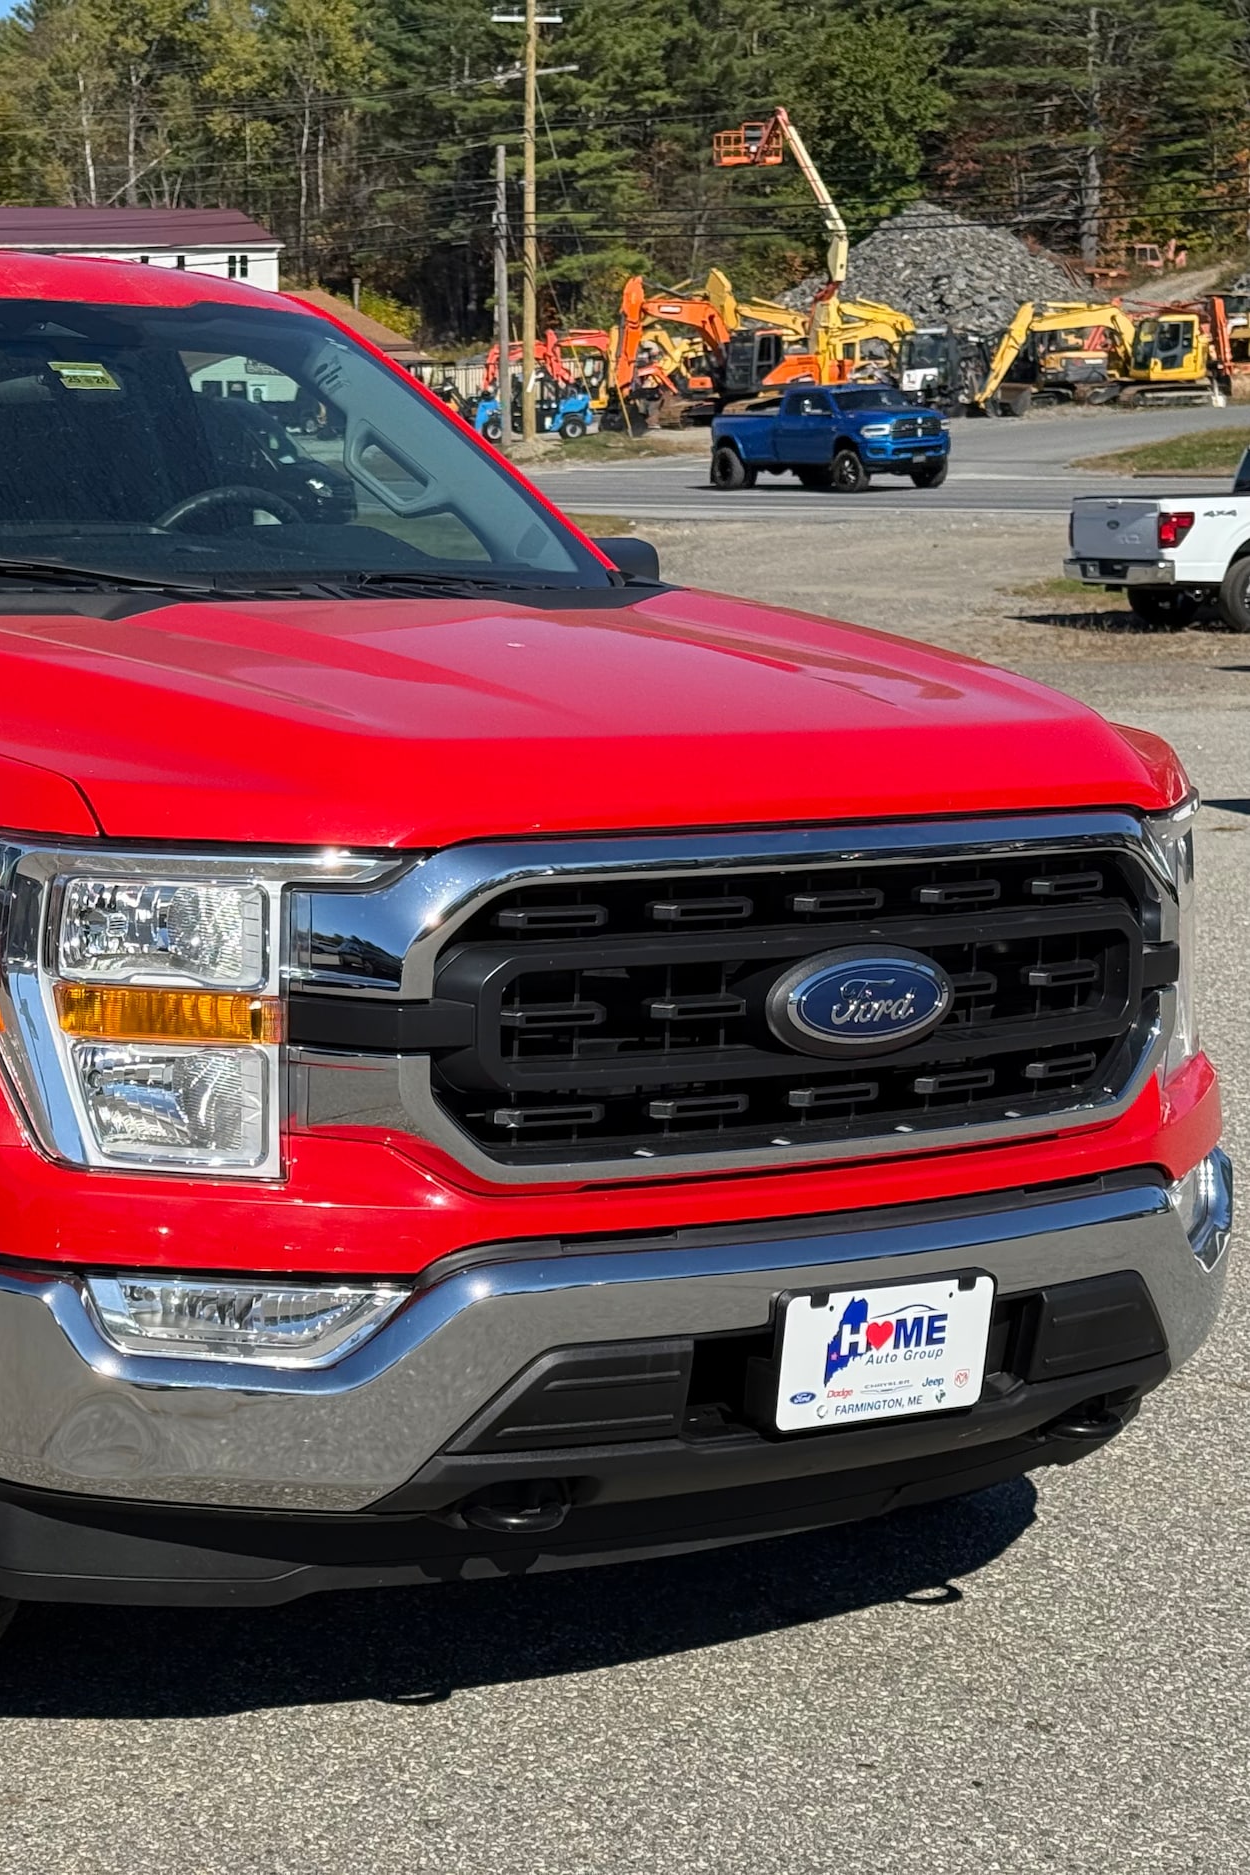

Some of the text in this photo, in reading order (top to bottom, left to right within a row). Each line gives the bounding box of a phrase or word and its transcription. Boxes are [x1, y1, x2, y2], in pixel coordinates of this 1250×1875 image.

[830, 978, 918, 1026] Ford
[864, 1348, 944, 1366] Auto Group
[864, 1379, 911, 1389] CHRYSLER
[921, 1376, 945, 1388] Jeep
[826, 1388, 854, 1399] Dodge
[834, 1395, 924, 1416] FARMINGTON, ME
